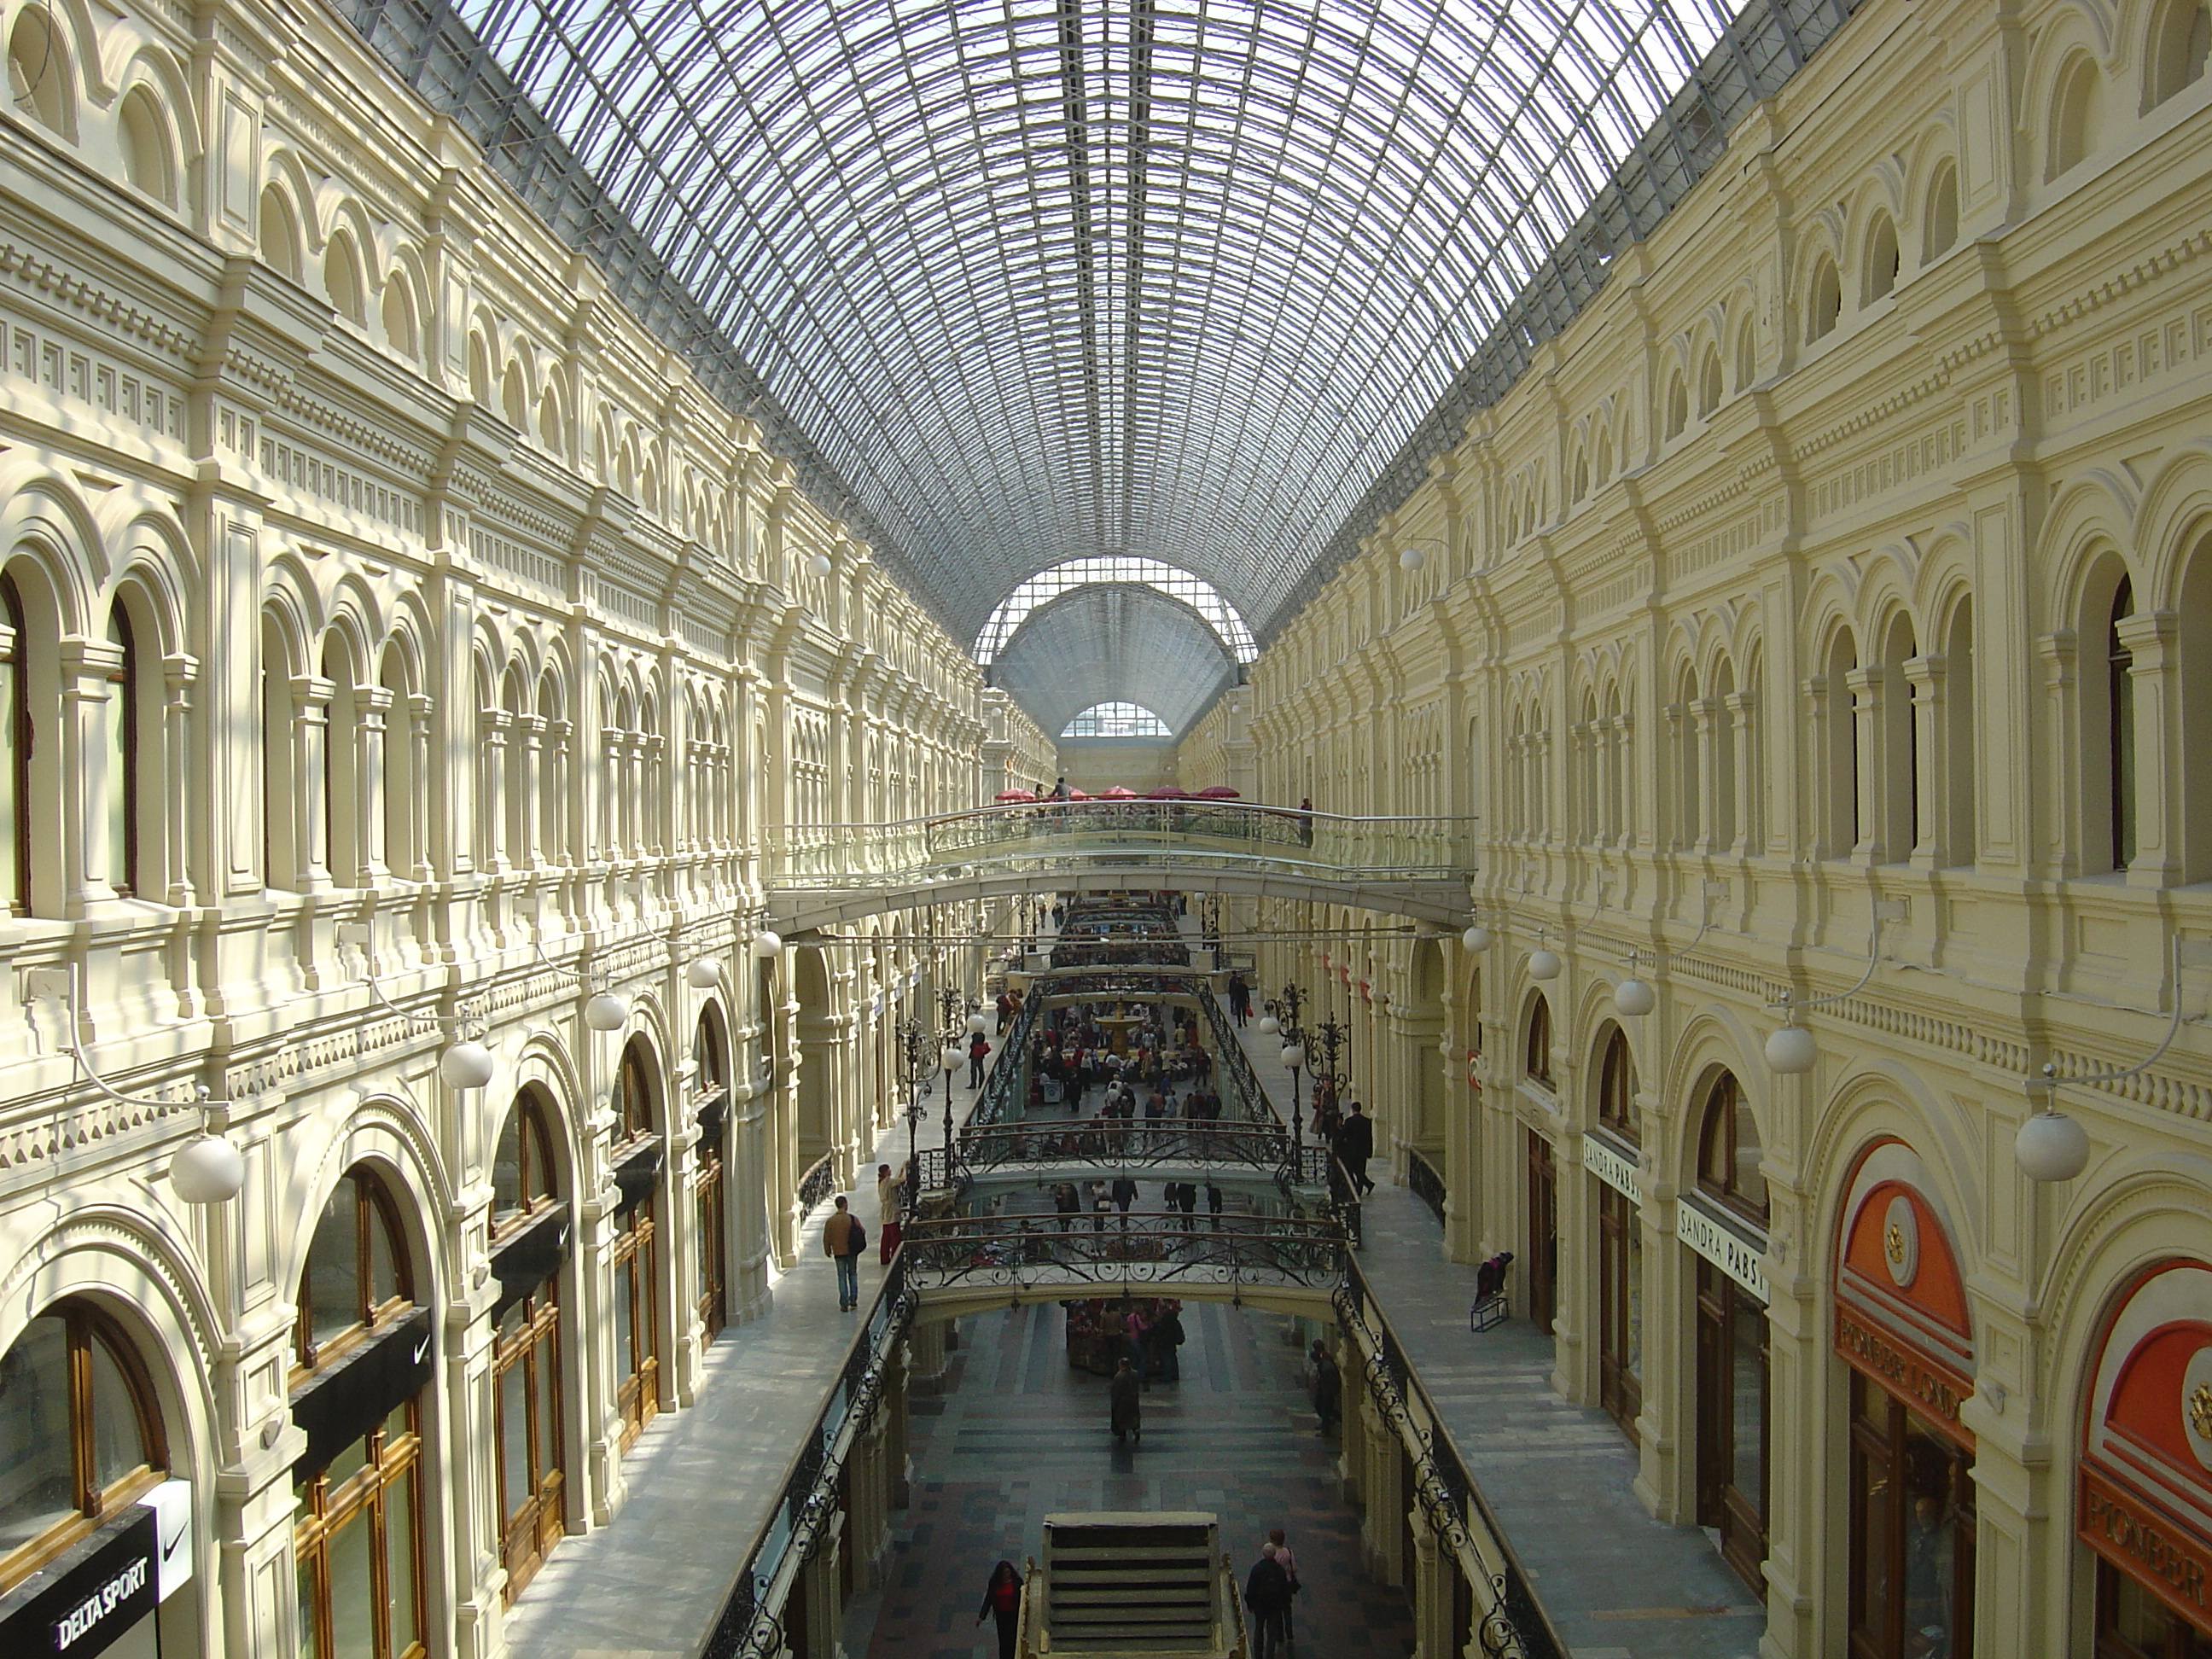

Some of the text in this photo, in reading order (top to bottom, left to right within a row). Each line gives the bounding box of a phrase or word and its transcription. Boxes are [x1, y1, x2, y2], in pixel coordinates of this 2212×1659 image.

[1585, 1143, 1614, 1179] SANDRA
[1680, 1209, 1722, 1260] SANDRA
[1840, 1317, 1906, 1387] PIONEER
[2091, 1493, 2205, 1606] PIONEER
[58, 1556, 148, 1650] DELTA SPORT
